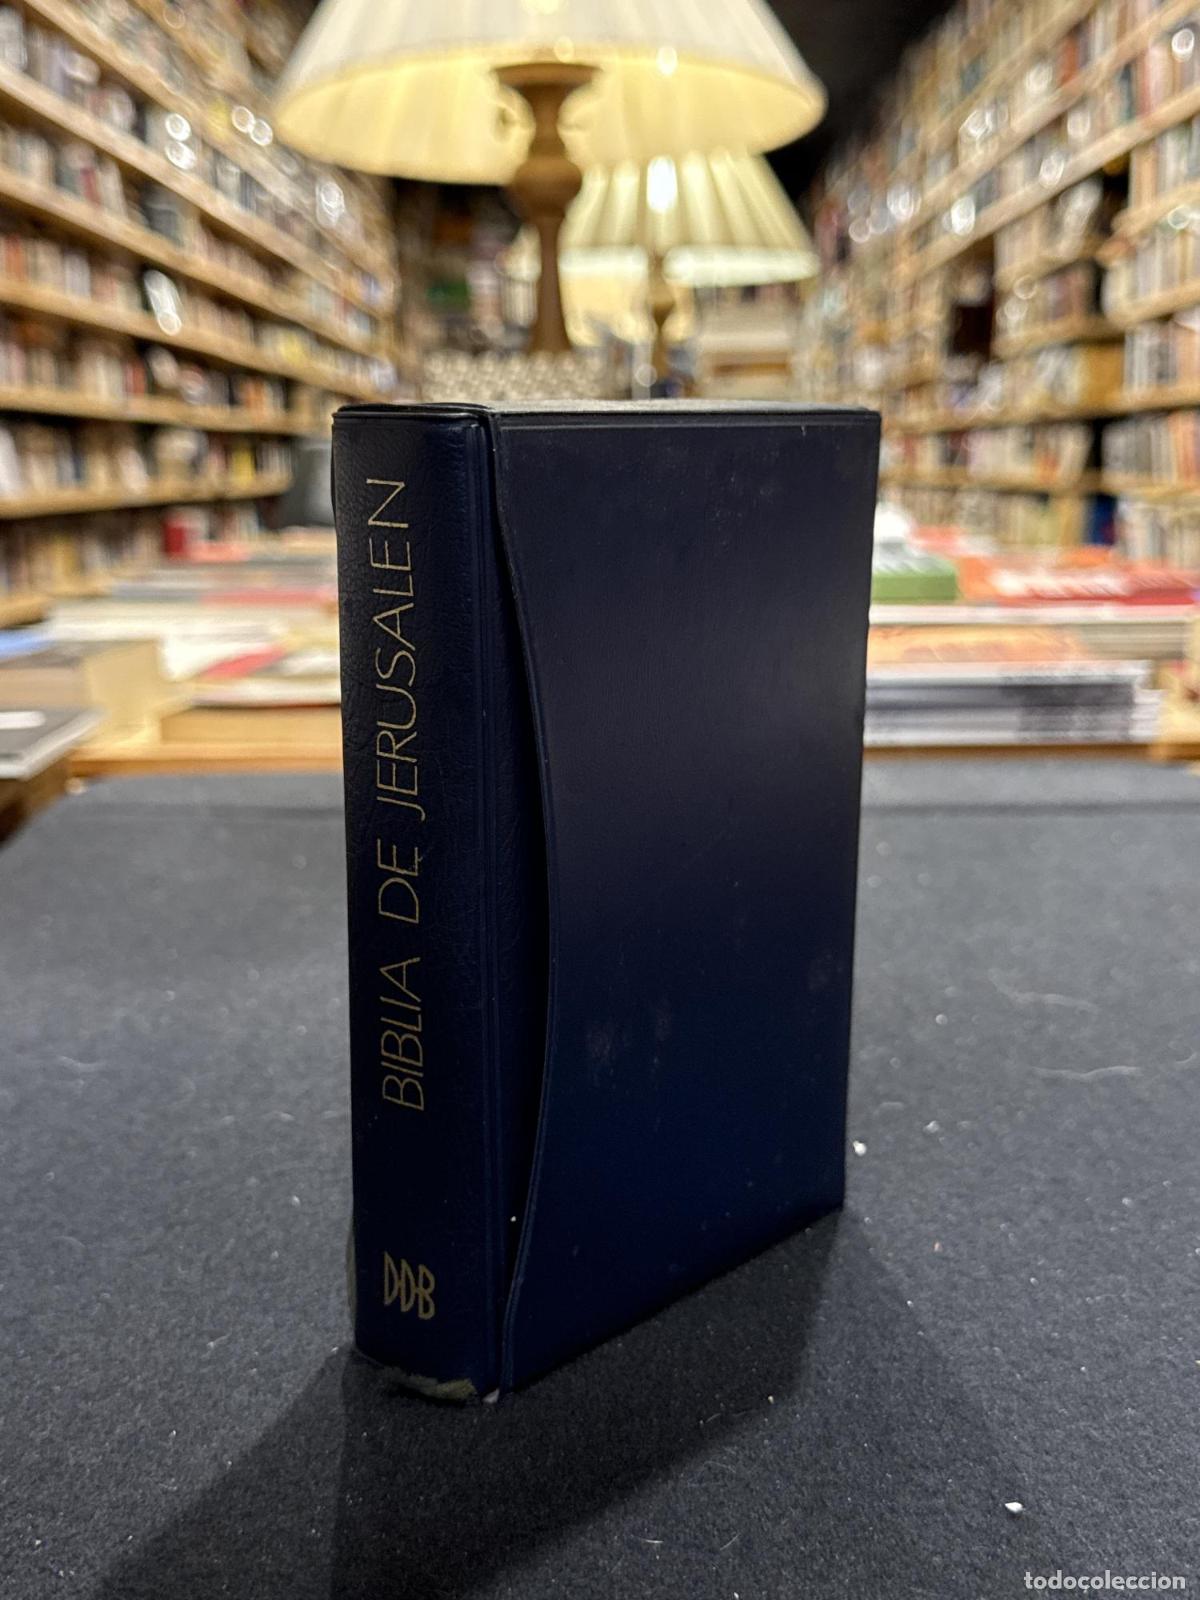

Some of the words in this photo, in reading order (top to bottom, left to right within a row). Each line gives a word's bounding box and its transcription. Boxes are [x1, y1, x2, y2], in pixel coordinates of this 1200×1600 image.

[366, 477, 426, 822] JERUSALEN
[376, 838, 420, 924] DE
[378, 956, 425, 1111] BIBLIA
[383, 1251, 436, 1320] DDB
